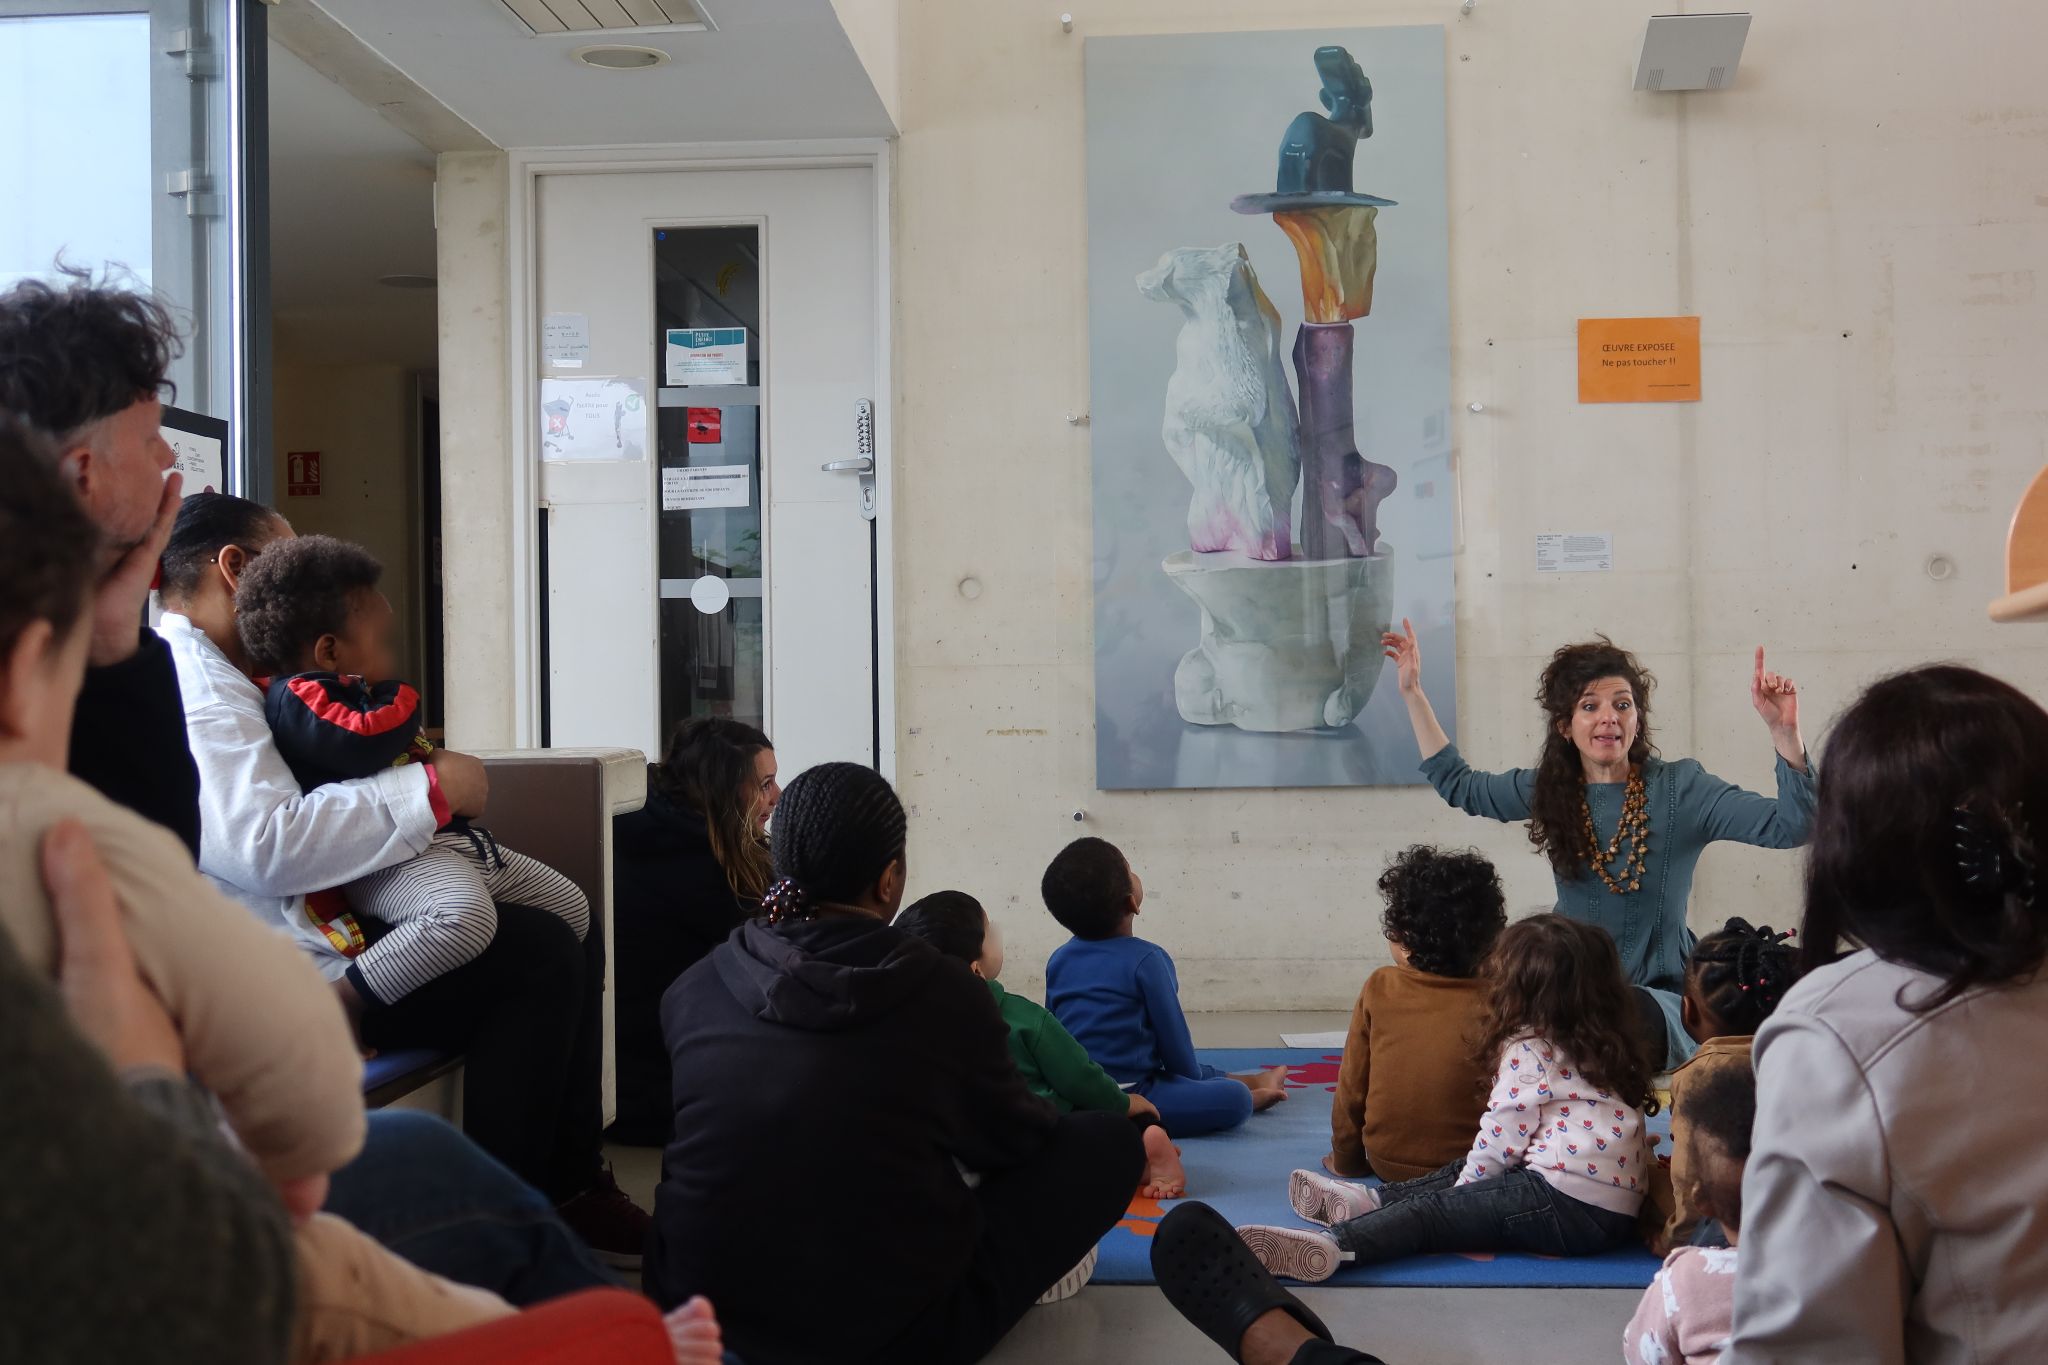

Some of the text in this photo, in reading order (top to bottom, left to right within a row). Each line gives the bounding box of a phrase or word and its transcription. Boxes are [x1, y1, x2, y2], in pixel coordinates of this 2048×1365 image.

[1602, 342, 1675, 352] ŒUVRE EXPOSEE
[1602, 357, 1676, 368] Ne pas toucher !!
